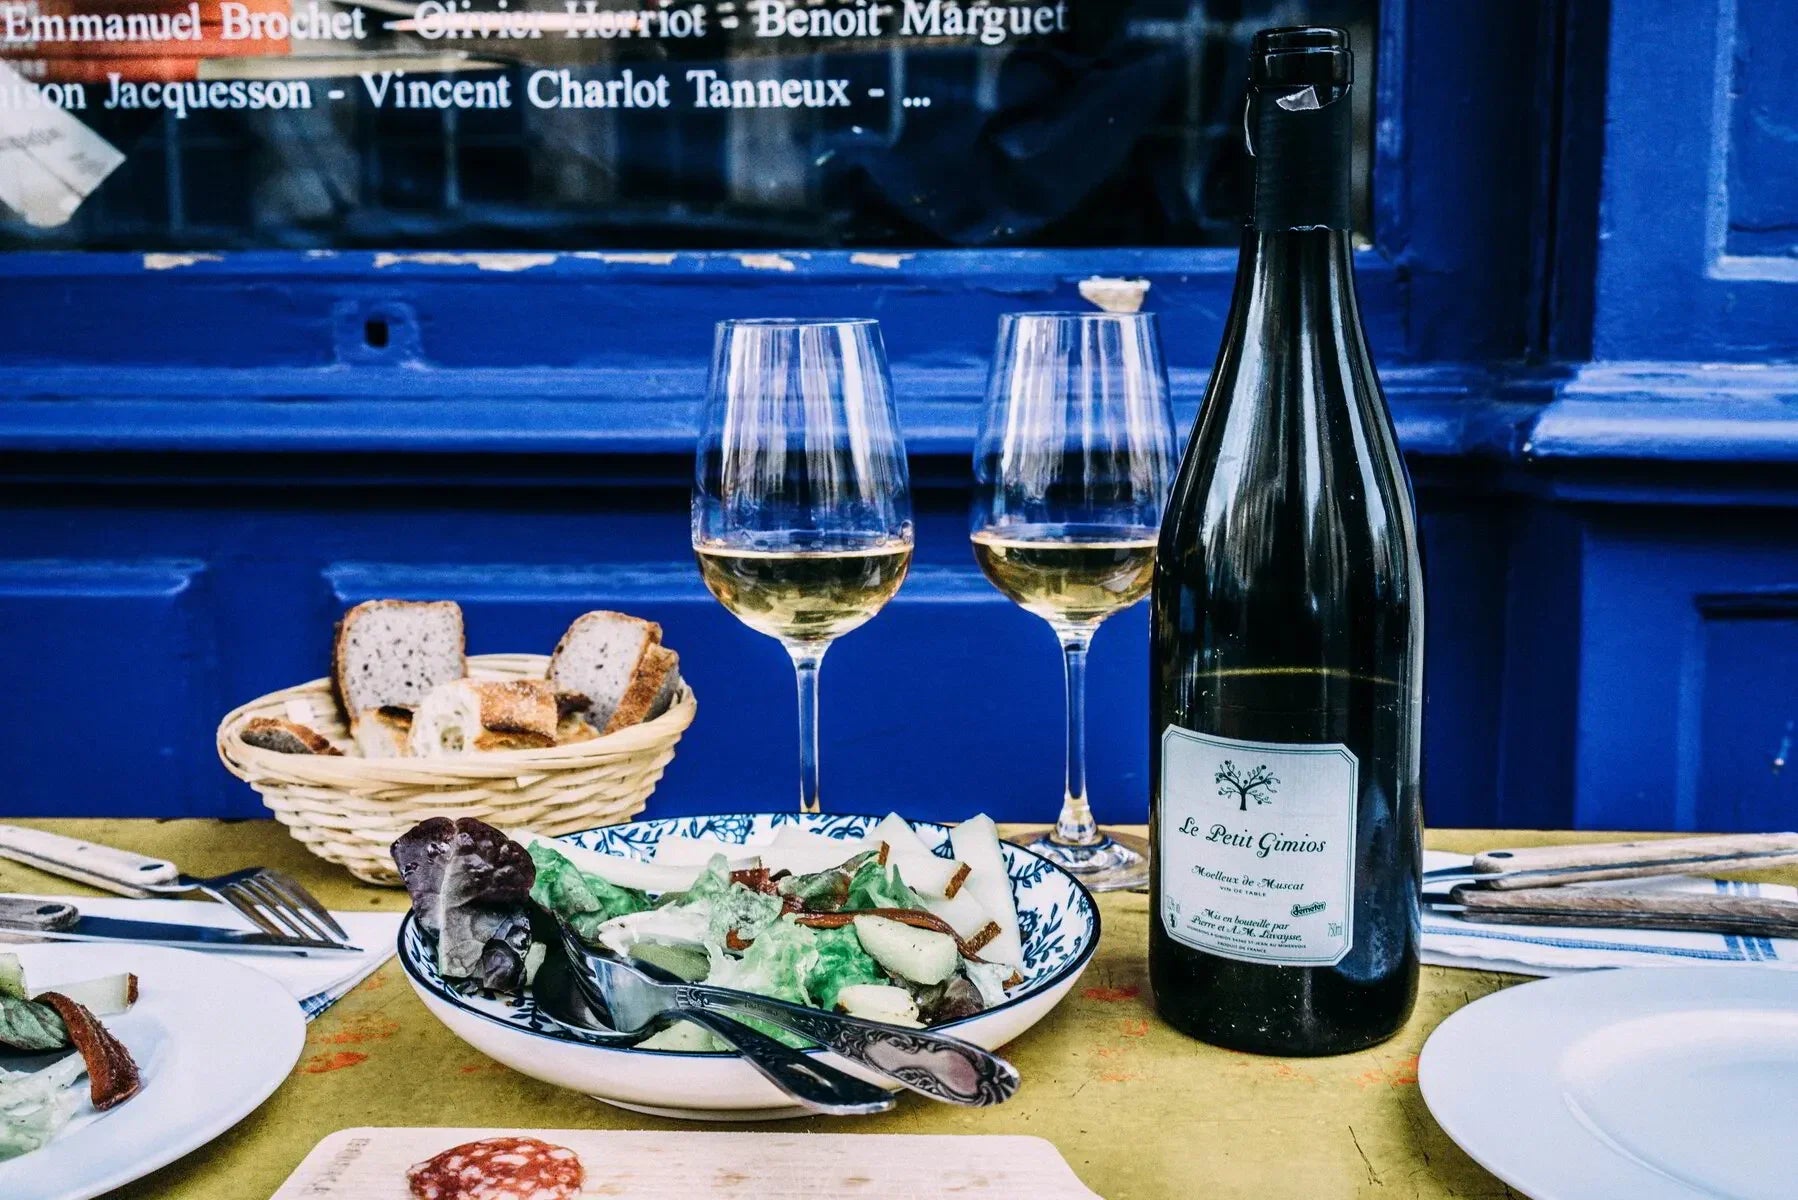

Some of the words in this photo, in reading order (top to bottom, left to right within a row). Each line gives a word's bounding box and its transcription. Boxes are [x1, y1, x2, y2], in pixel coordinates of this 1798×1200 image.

[4, 3, 202, 42] Emmanuel
[221, 1, 367, 41] Brochet
[414, 0, 543, 40] Olivier
[755, 0, 883, 38] Benoit
[900, 0, 1069, 45] Marguet
[104, 72, 312, 119] Jacquesson
[361, 71, 512, 109] Vincent
[526, 70, 671, 109] Charlot
[686, 70, 851, 109] Tanneux
[1178, 816, 1199, 837] Le
[1205, 823, 1254, 849] Petit
[1256, 832, 1326, 858] Gimios
[1191, 864, 1239, 884] Moelleux
[1242, 874, 1255, 887] de
[1257, 878, 1304, 891] Muscat
[1191, 915, 1216, 929] Pierre
[1217, 924, 1225, 932] et
[1201, 908, 1221, 920] Mis
[1222, 915, 1233, 923] en
[1234, 915, 1271, 929] bouteille
[1271, 922, 1290, 932] par
